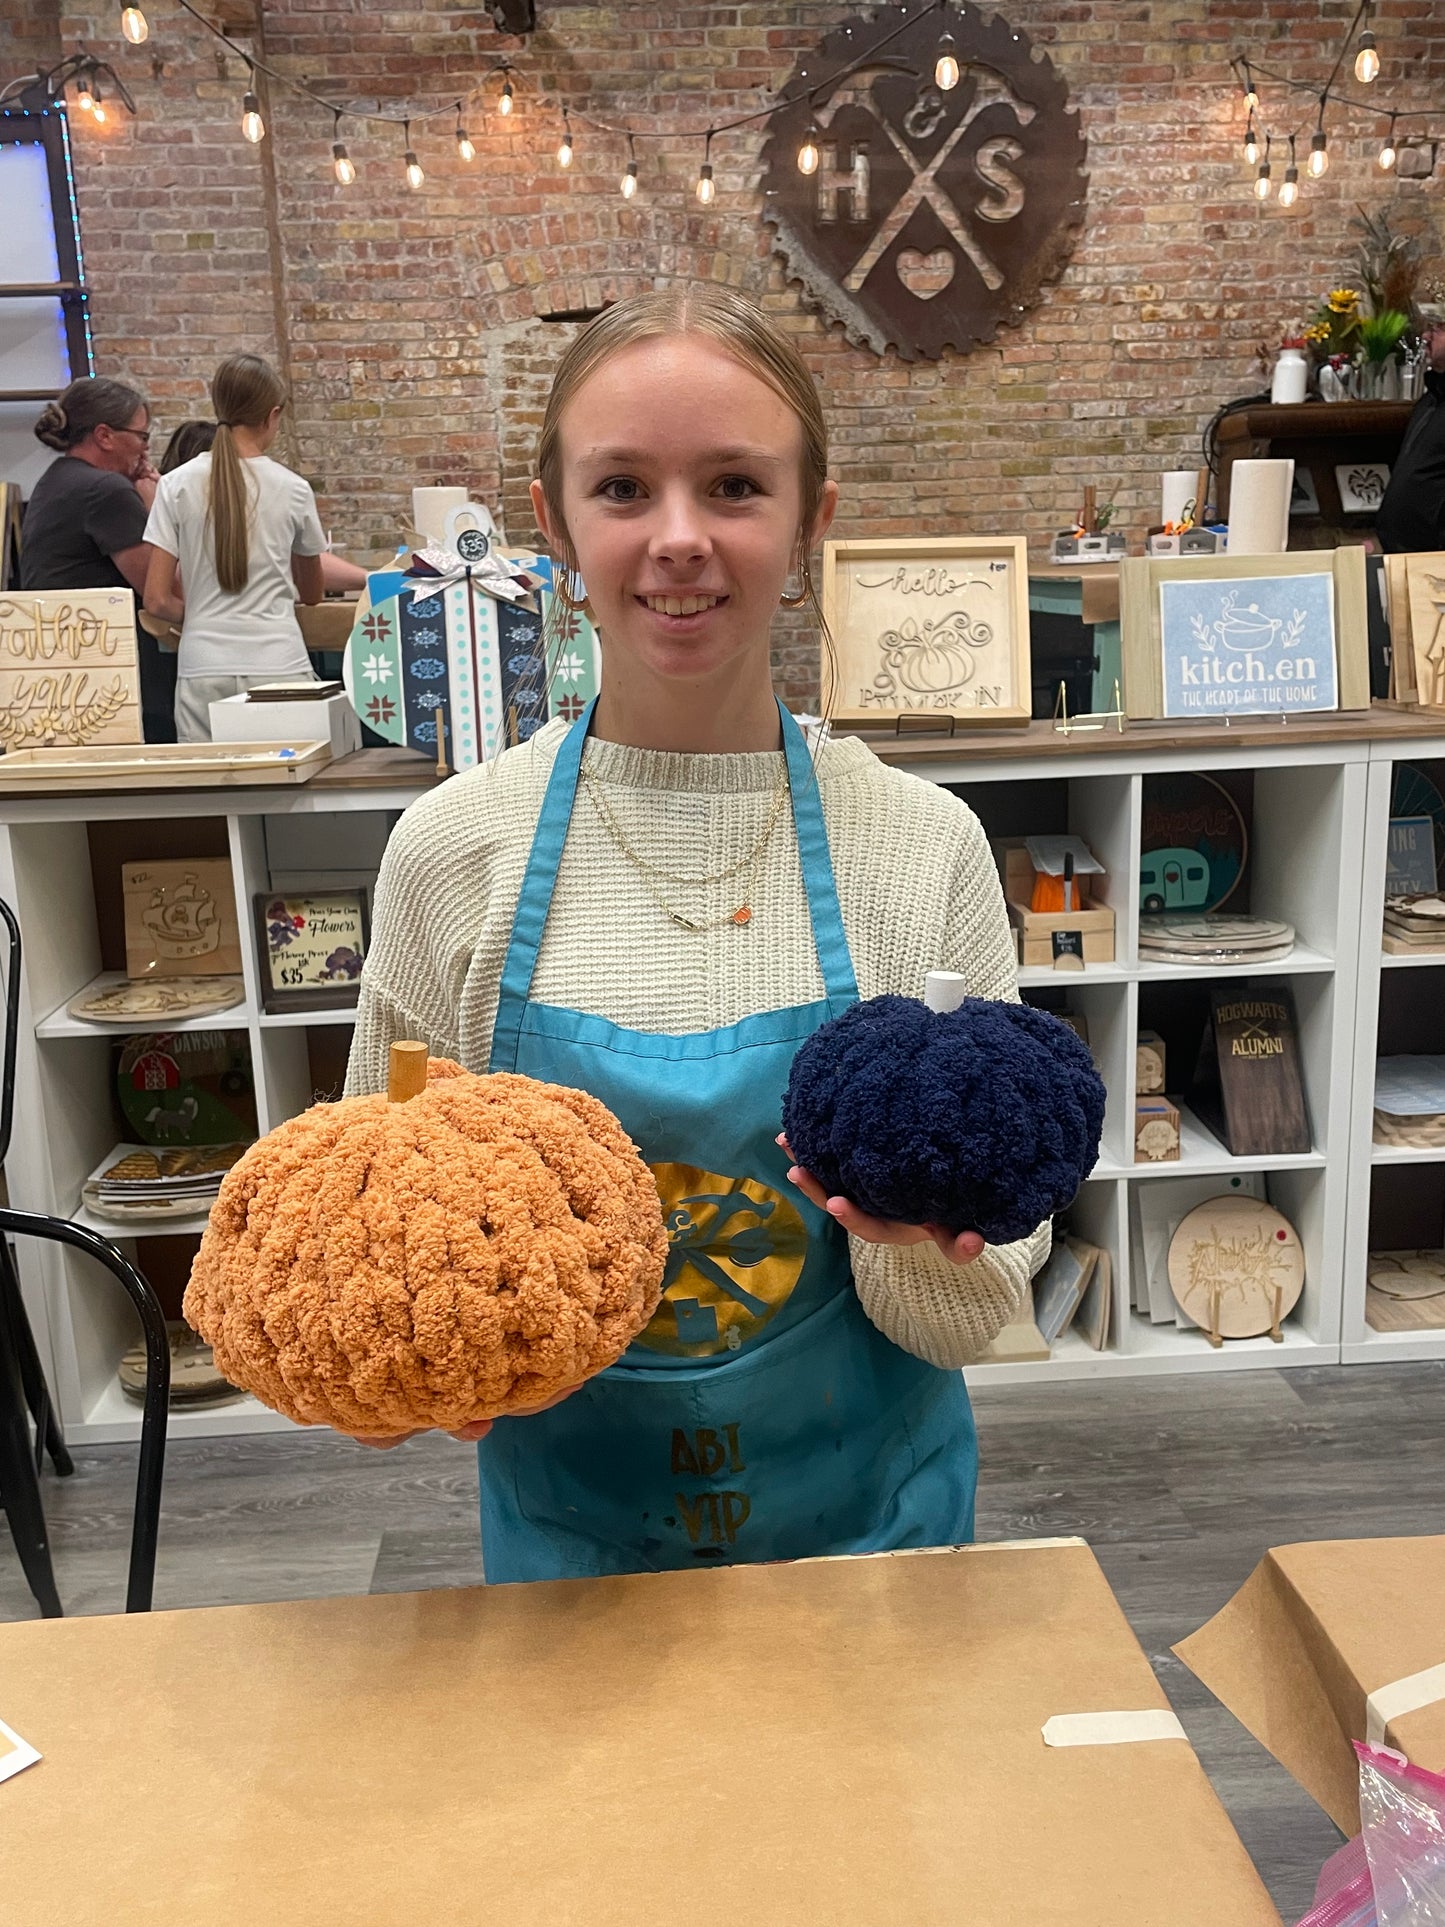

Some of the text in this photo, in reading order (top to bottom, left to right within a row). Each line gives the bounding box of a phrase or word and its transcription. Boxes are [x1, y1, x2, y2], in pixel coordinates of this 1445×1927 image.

[818, 135, 1026, 224] H S
[866, 567, 985, 597] hello
[0, 600, 118, 660] ather
[1180, 652, 1317, 686] kitch.en
[1182, 690, 1201, 707] THE
[1205, 689, 1240, 706] HEART
[1262, 687, 1282, 703] THE
[1286, 685, 1318, 702] HOME
[308, 918, 355, 938] Flowers
[280, 966, 304, 985] $35
[1216, 1002, 1287, 1024] HOGWARTS
[173, 1030, 226, 1053] DAWSON
[1231, 1037, 1284, 1055] ALUMNI
[670, 1422, 747, 1475] ABI
[674, 1491, 752, 1544] VIP
